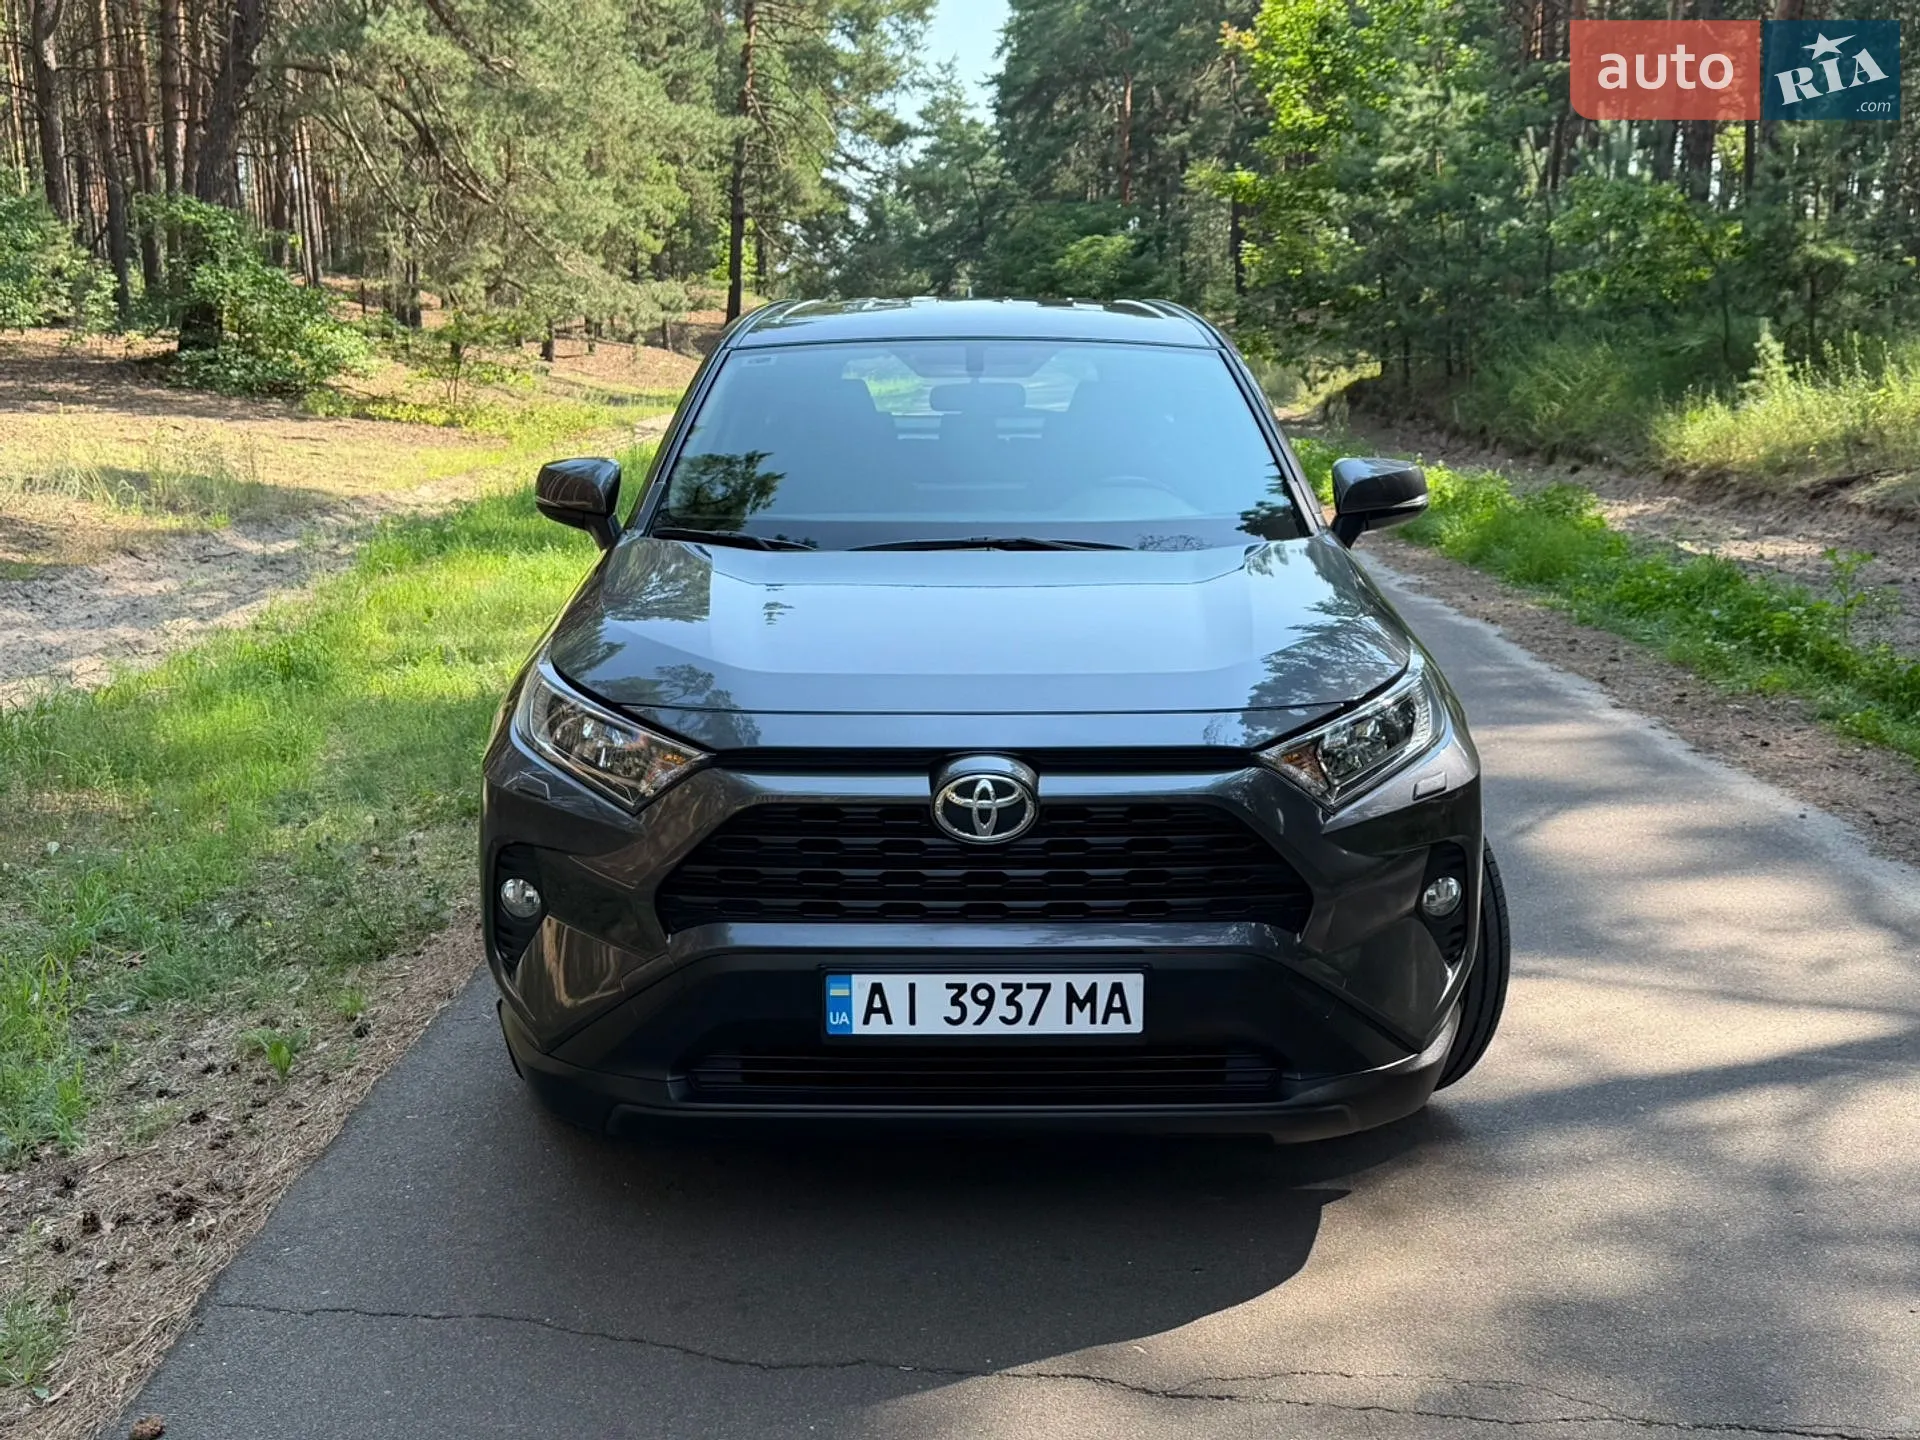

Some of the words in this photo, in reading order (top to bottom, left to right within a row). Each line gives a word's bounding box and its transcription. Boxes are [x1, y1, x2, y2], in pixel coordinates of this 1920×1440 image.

[829, 1011, 849, 1026] UA
[862, 982, 917, 1026] AI
[943, 982, 1052, 1026] 3937
[1065, 982, 1131, 1026] MA
